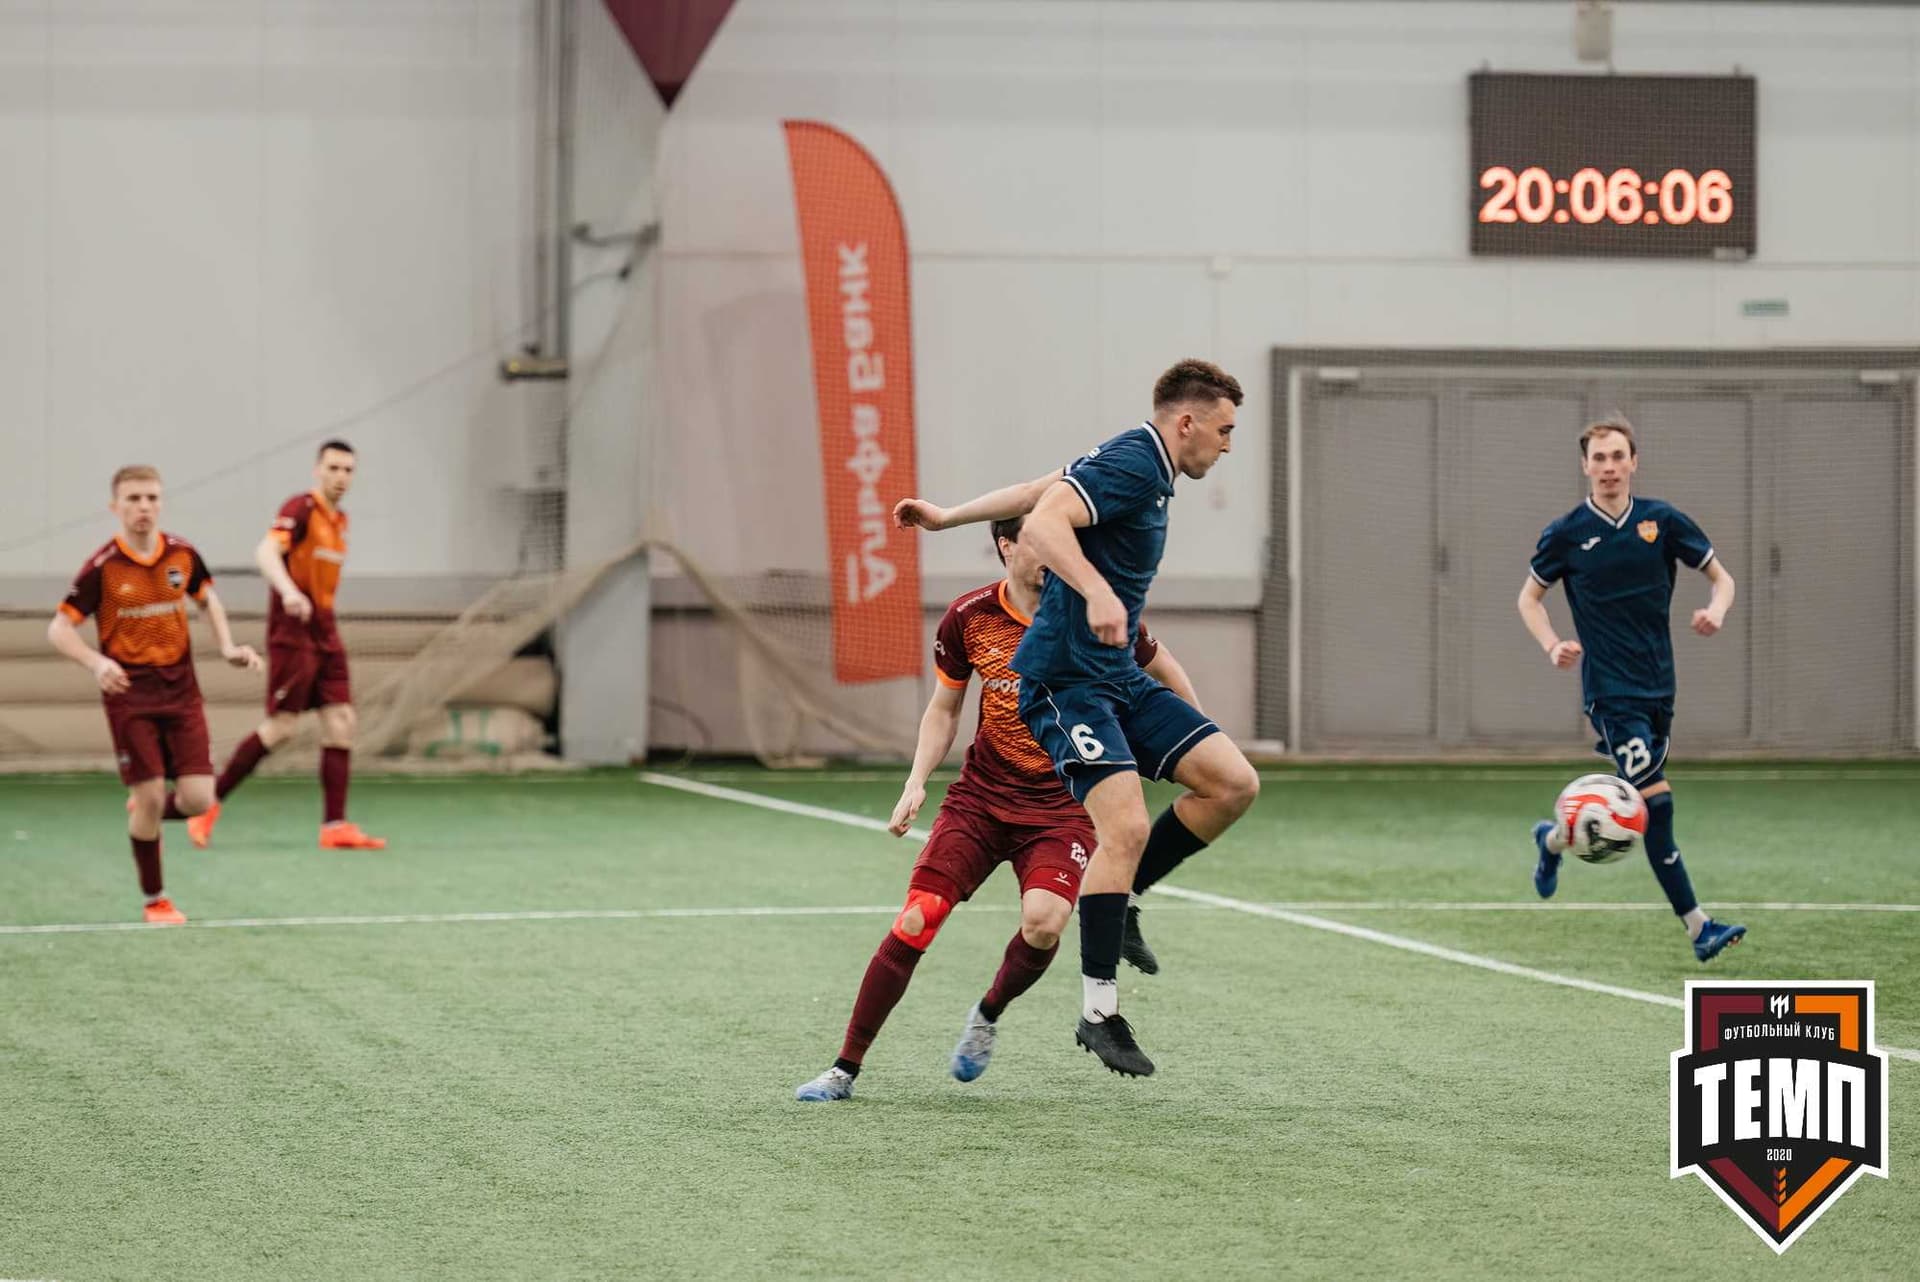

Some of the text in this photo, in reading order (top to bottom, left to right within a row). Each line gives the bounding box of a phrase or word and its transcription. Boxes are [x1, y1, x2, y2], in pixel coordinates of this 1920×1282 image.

[1478, 166, 1733, 225] 20:06:06
[1070, 722, 1104, 760] 6
[1616, 735, 1651, 778] 23
